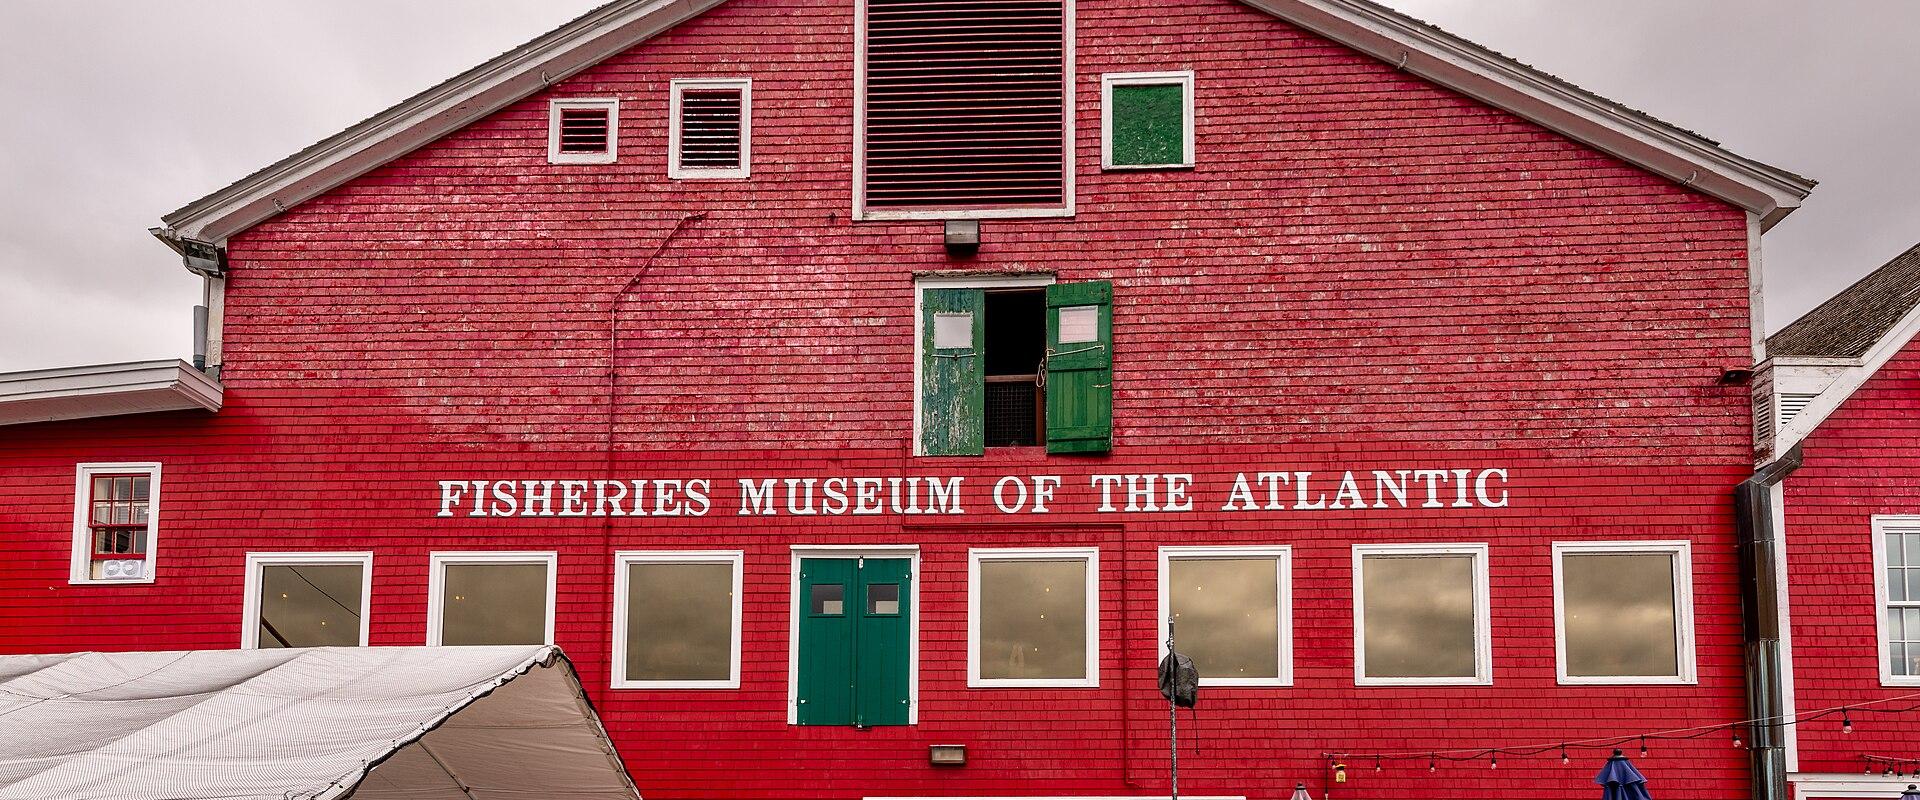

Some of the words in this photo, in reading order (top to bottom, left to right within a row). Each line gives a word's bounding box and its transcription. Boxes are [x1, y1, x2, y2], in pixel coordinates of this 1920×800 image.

[437, 479, 711, 517] FISHERIES
[739, 477, 965, 516] MUSEUM
[994, 475, 1062, 514] OF
[1091, 474, 1194, 513] THE
[1222, 468, 1509, 511] ATLANTIC
